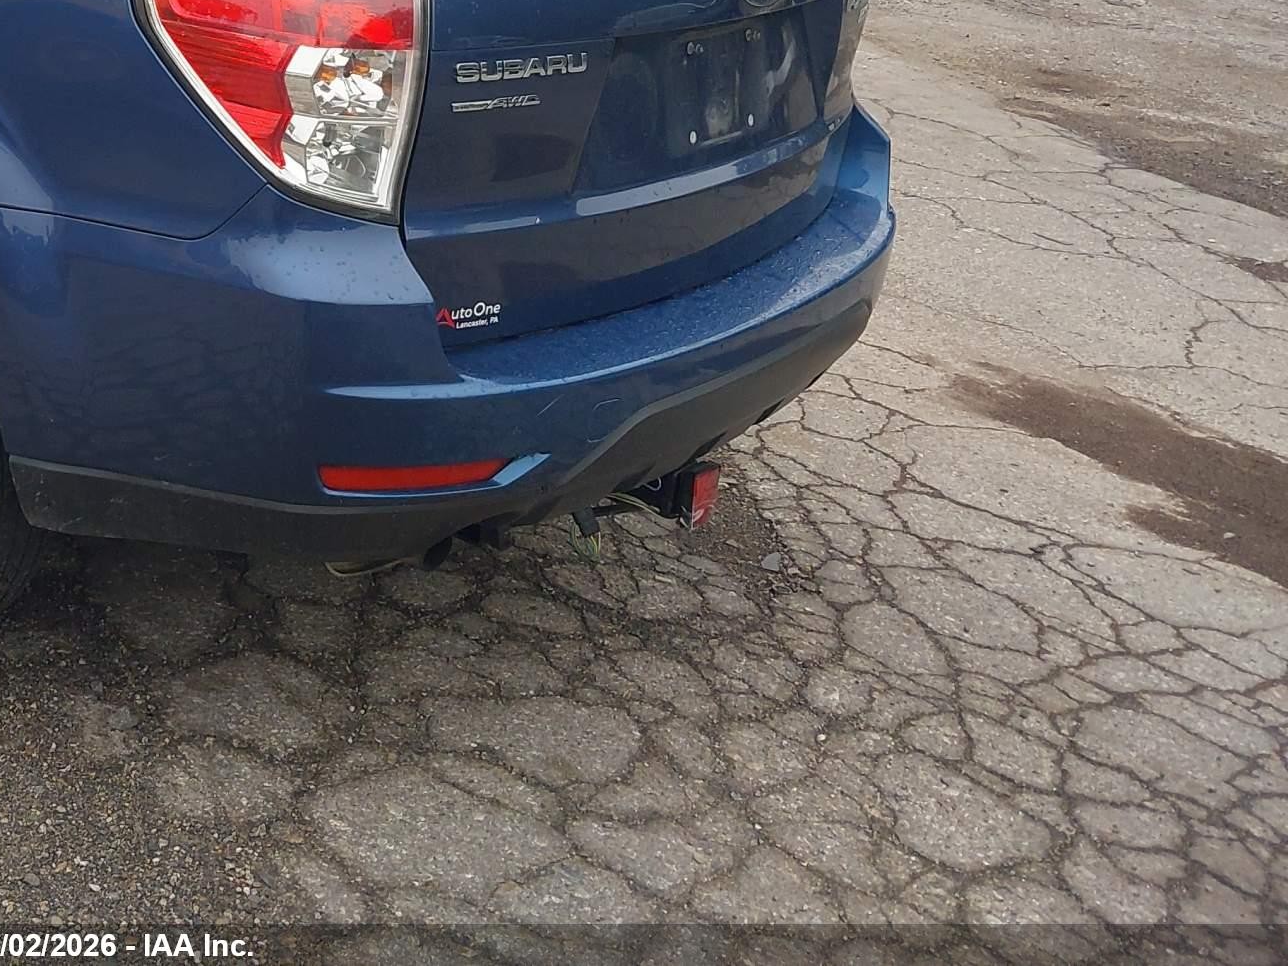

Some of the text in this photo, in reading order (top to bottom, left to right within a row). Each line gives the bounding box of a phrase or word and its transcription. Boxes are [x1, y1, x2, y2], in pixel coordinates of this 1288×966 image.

[456, 52, 588, 83] SUBARU
[487, 94, 541, 110] AWD
[456, 316, 499, 329] Lancaster, PA
